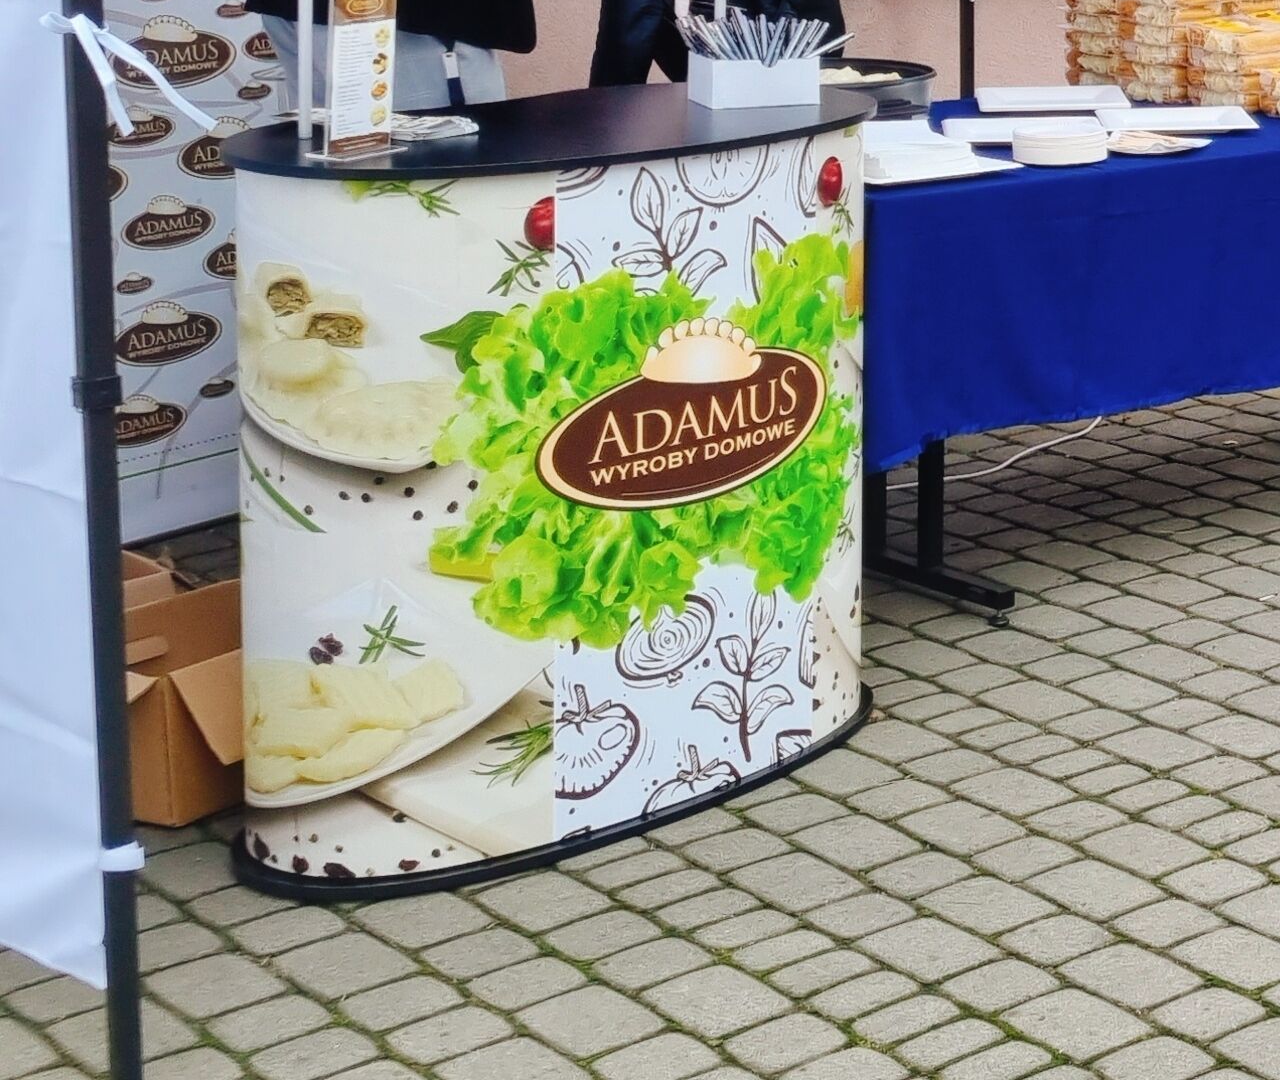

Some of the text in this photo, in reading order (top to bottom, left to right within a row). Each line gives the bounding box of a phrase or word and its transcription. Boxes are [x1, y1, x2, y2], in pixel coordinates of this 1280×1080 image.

[127, 39, 219, 69] DAMUS
[135, 211, 203, 237] ADAMUS
[127, 319, 207, 352] ADAMUS
[116, 408, 175, 434] DAMUS
[588, 366, 798, 464] ADAMUS
[589, 418, 797, 487] WYROBY DOMOWE
